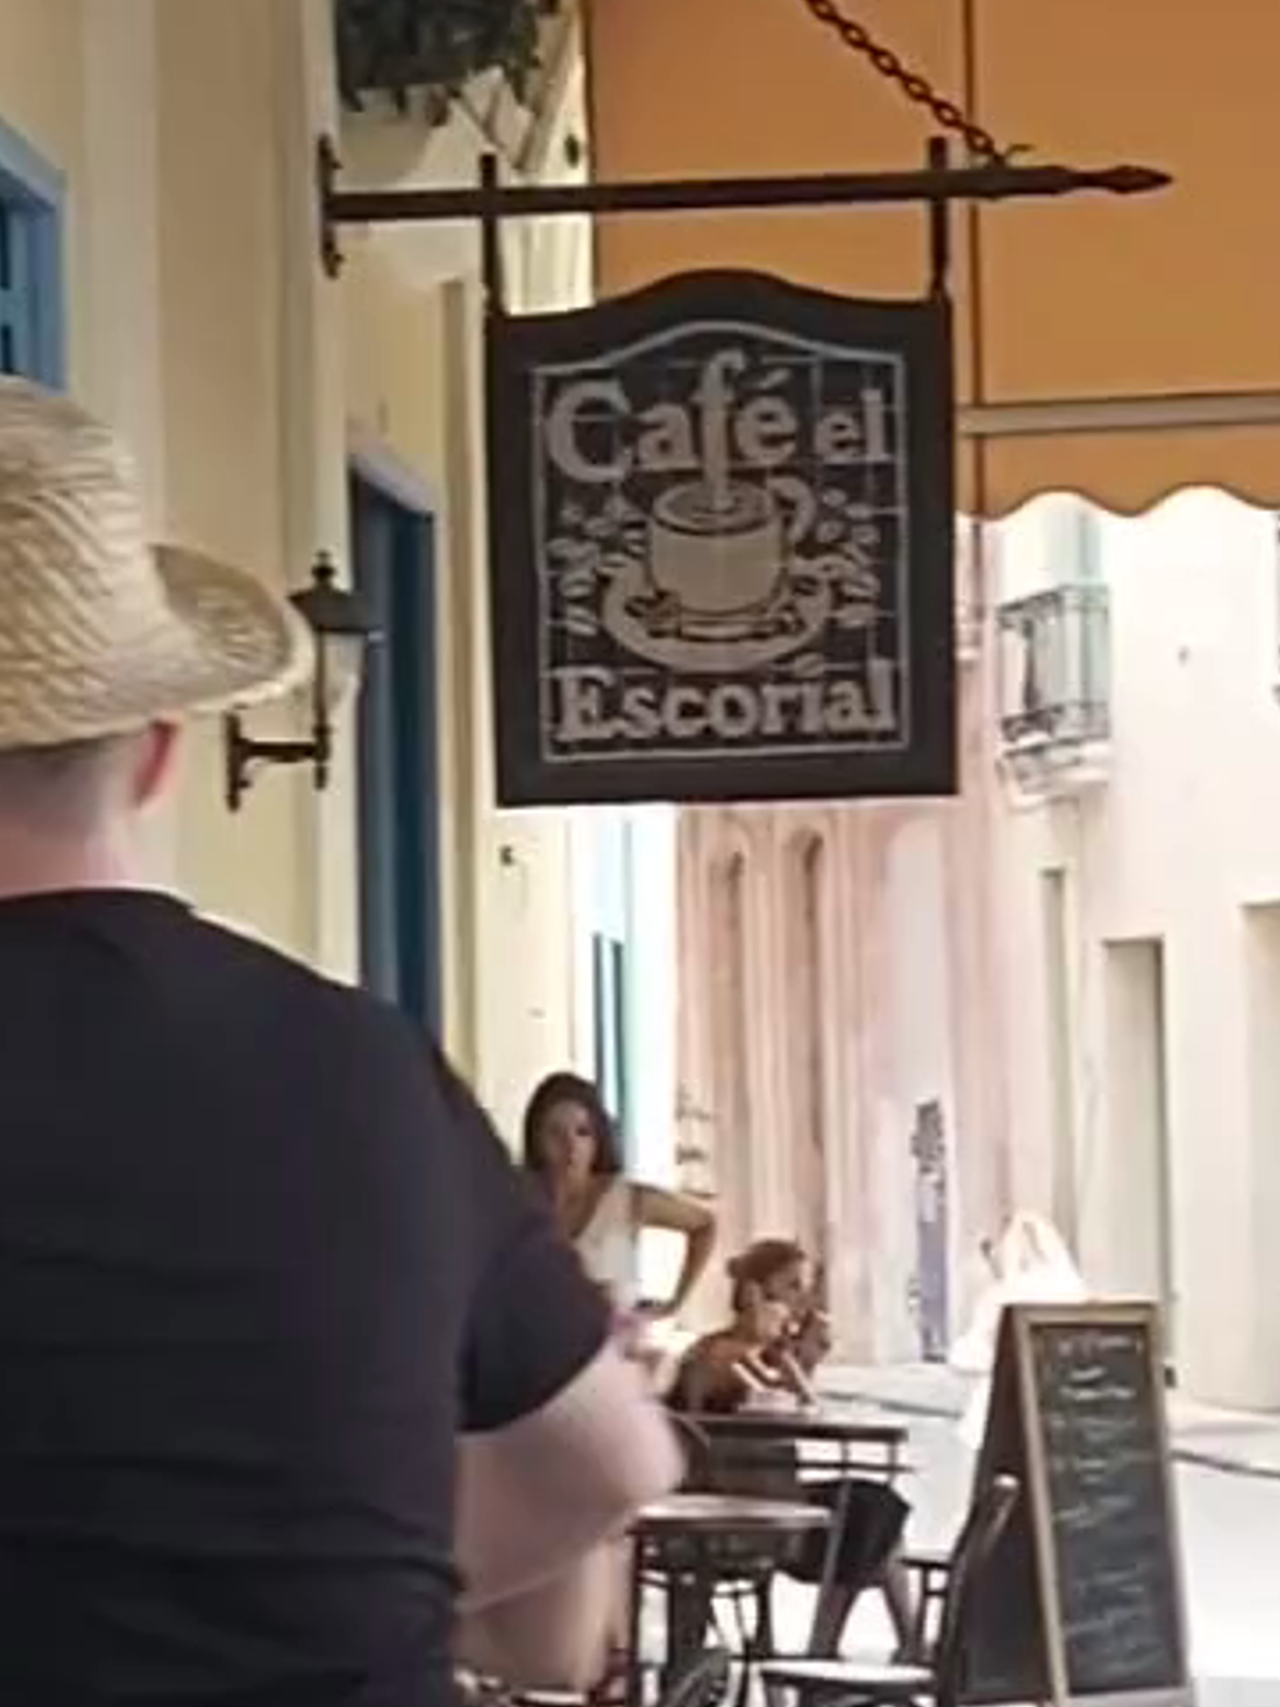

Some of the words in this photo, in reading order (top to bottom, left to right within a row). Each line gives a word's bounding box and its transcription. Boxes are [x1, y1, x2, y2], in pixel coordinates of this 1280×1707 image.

[547, 349, 799, 486] Café
[814, 388, 891, 465] el
[551, 659, 896, 742] Escorial
